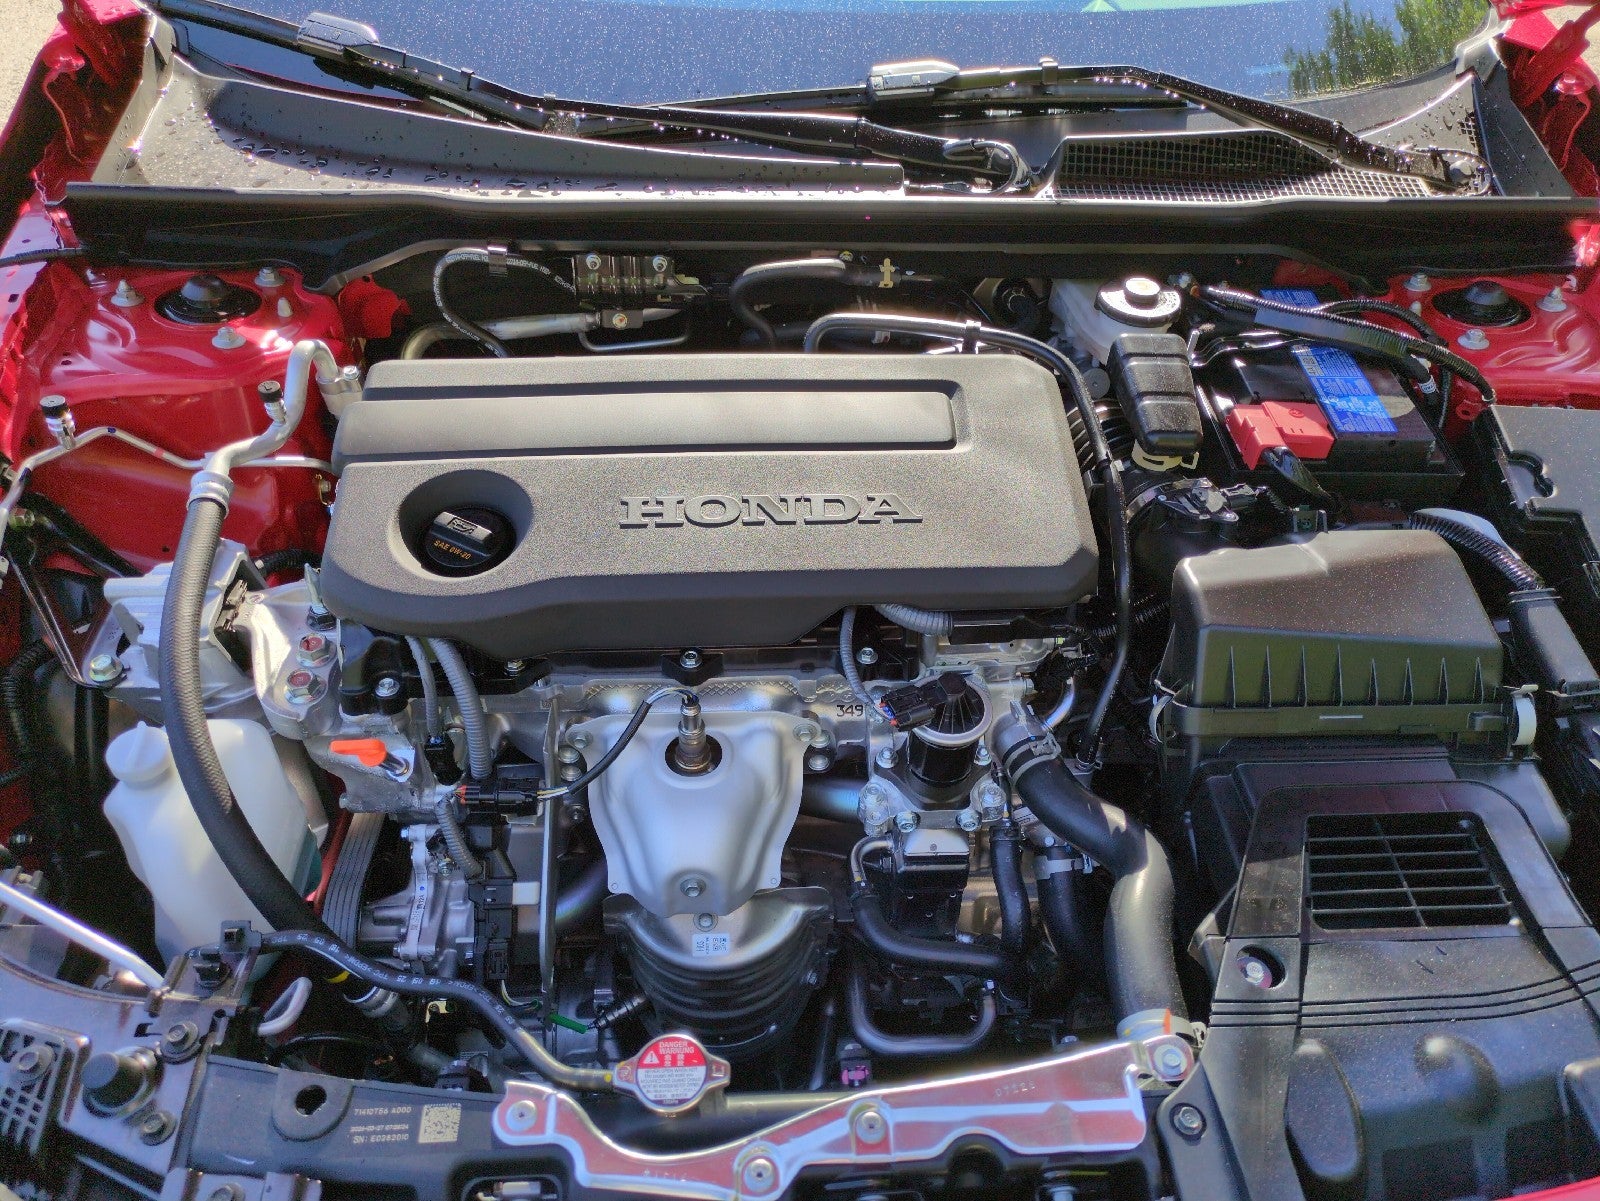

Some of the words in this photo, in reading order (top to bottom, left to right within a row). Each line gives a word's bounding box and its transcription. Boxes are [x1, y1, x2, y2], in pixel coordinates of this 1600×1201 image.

[619, 493, 923, 529] HONDA
[433, 540, 450, 551] SAE
[449, 546, 472, 560] 0W-20
[836, 704, 864, 717] 349
[391, 1106, 412, 1114] A000
[353, 1135, 368, 1144] SN:
